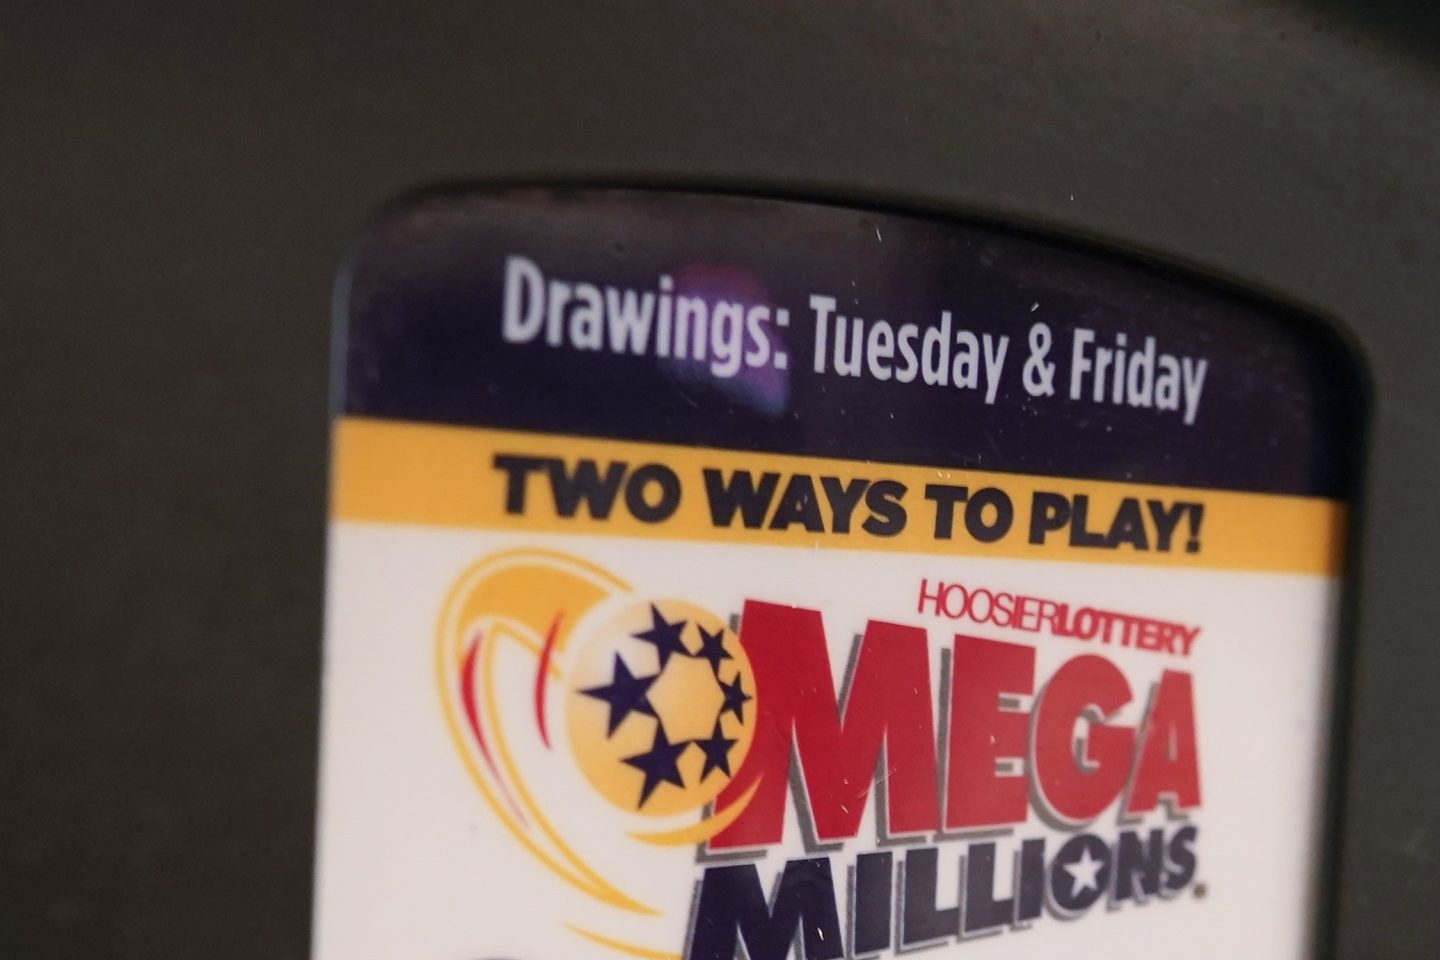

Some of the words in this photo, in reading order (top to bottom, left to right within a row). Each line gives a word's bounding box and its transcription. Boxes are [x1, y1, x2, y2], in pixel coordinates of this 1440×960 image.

[502, 255, 790, 373] Drawings:
[810, 295, 1008, 403] Tuesday
[1021, 323, 1056, 399] &
[1069, 328, 1207, 424] Friday
[491, 453, 682, 525] TWO
[703, 467, 908, 539] WAYS
[924, 484, 1014, 546] TO
[1028, 491, 1206, 554] PLAY!
[703, 597, 1203, 860] MEGA
